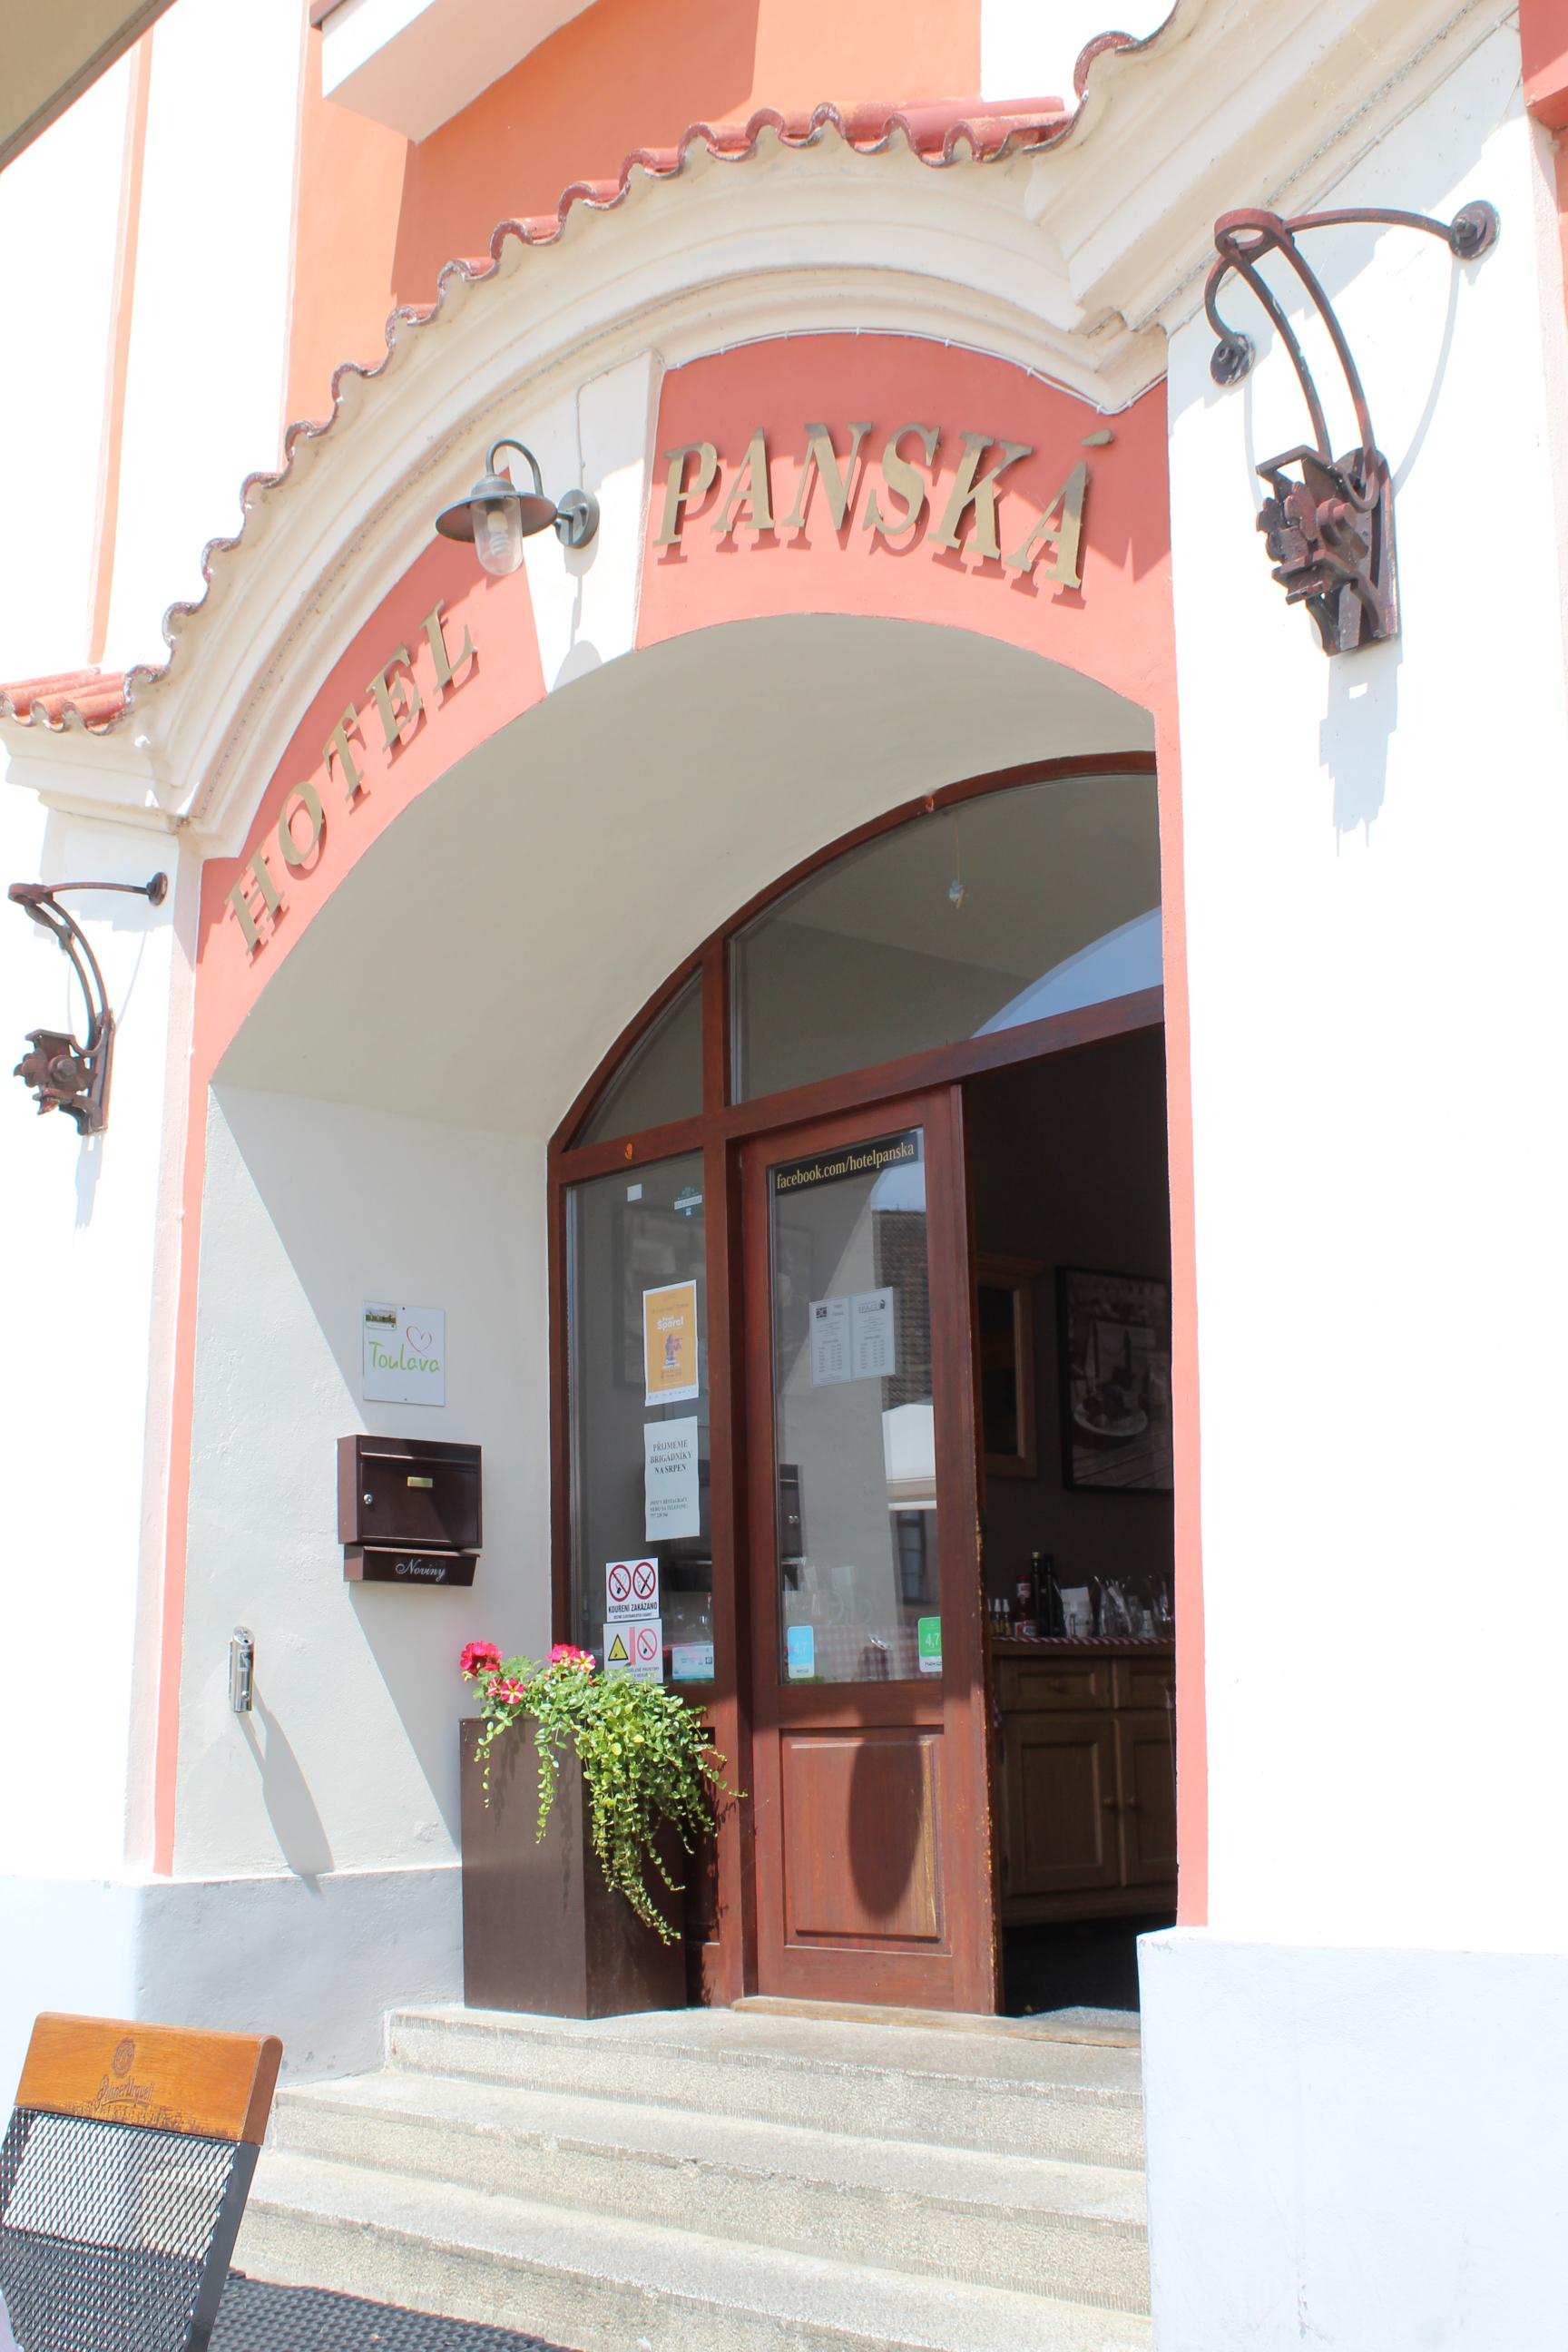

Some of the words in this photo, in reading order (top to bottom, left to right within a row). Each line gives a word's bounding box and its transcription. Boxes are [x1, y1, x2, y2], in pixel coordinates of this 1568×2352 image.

[224, 600, 478, 956] HOTEL
[652, 422, 1115, 589] PANSKÁ
[776, 1142, 915, 1190] facebook.com/hotelpanska
[368, 1340, 441, 1373] Toulava
[664, 1464, 687, 1474] SRPEN
[395, 1558, 446, 1583] Noviny
[608, 1603, 631, 1613] KOUŘENÍ
[631, 1601, 658, 1612] ZAKÁZÁNO
